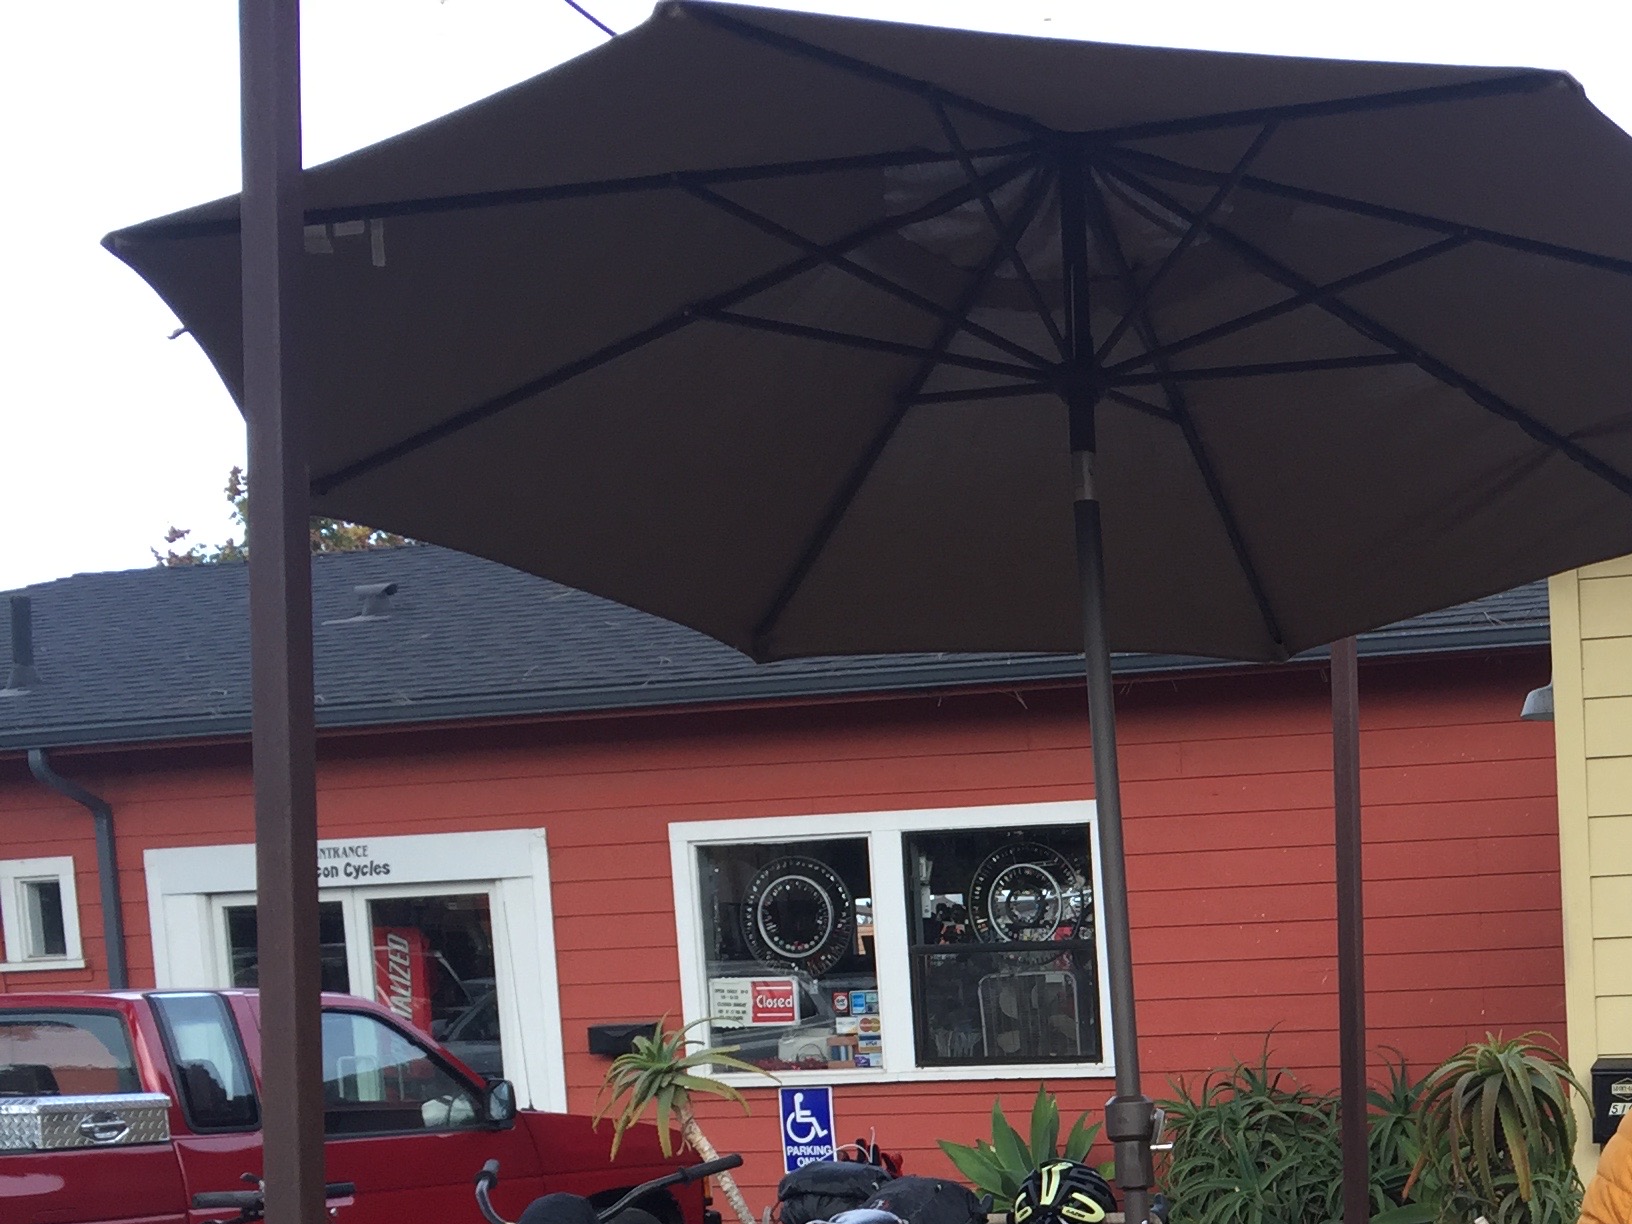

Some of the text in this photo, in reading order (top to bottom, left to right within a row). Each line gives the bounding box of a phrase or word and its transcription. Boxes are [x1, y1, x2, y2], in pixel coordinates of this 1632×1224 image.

[319, 845, 368, 859] NTRANCE
[344, 860, 390, 879] Cycles
[387, 933, 412, 1020] IALIZED
[756, 995, 793, 1008] Closed
[786, 1145, 832, 1156] PARKING
